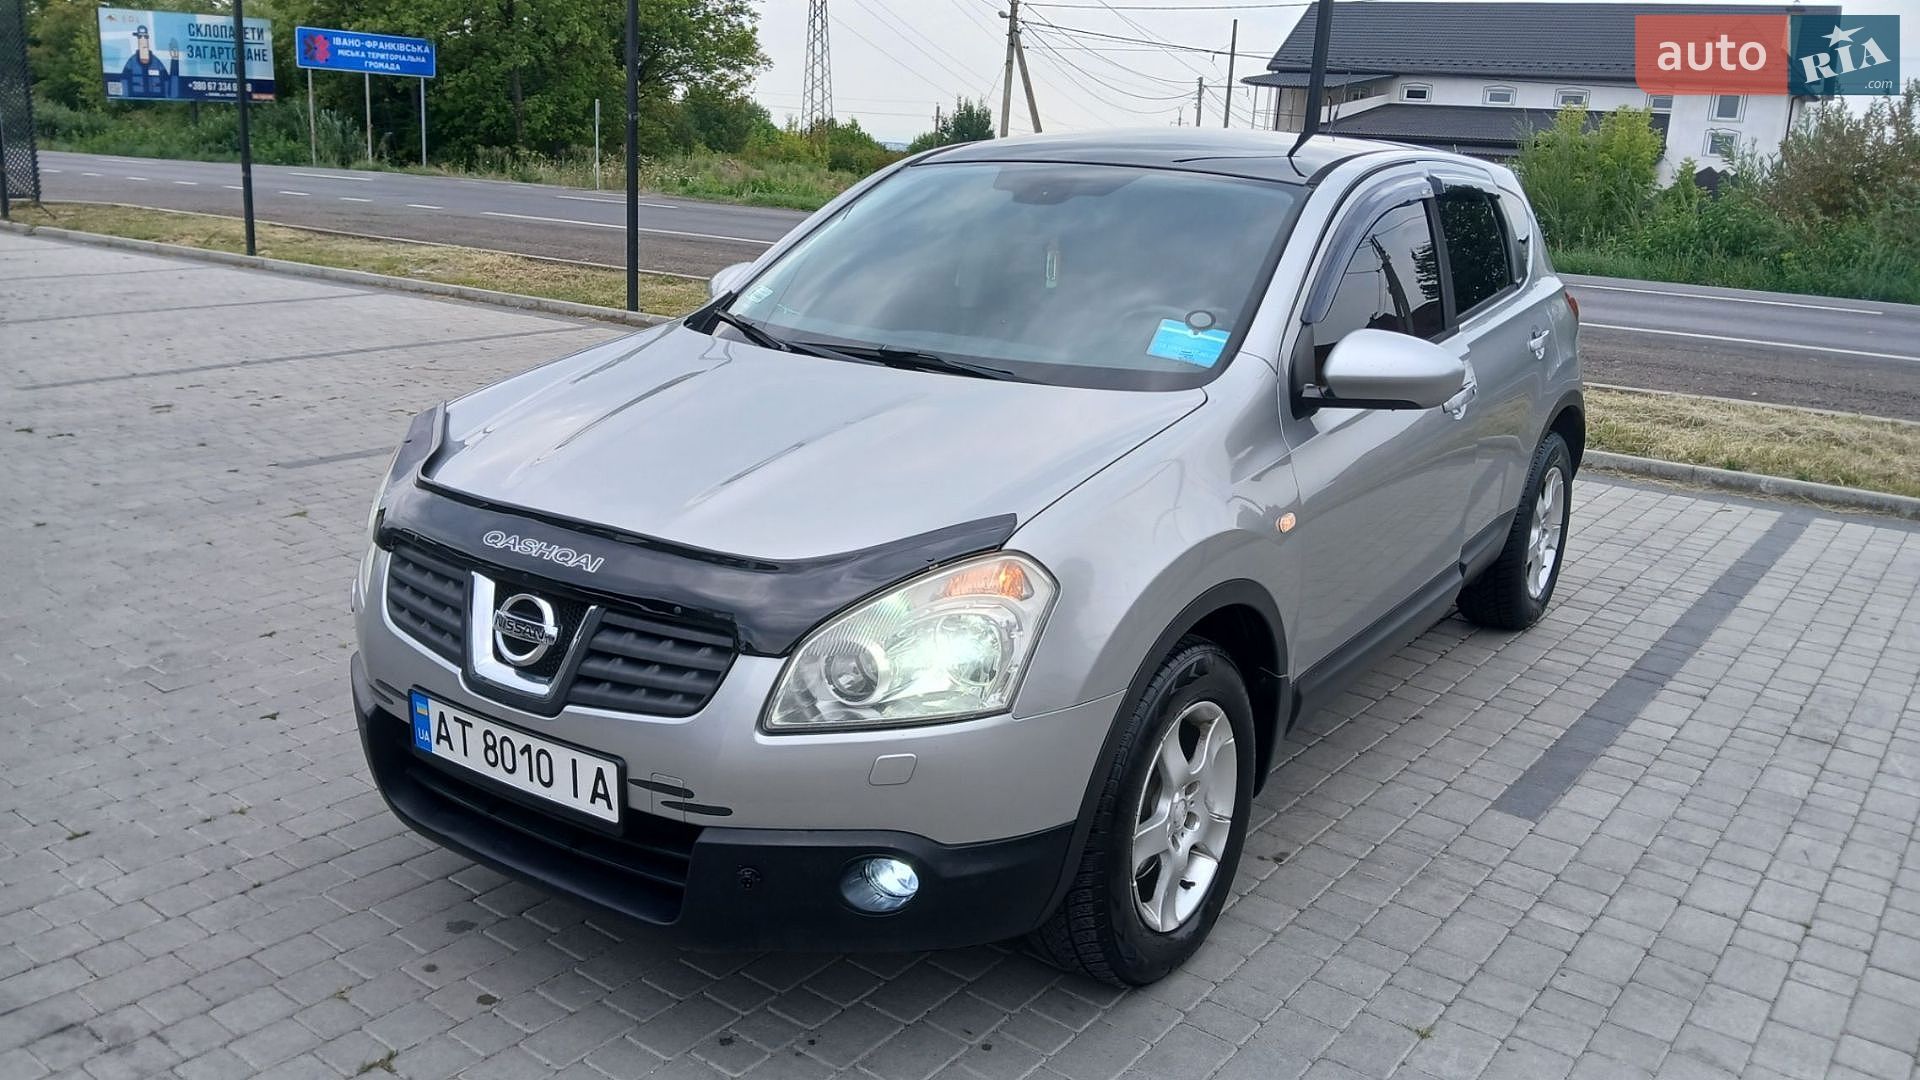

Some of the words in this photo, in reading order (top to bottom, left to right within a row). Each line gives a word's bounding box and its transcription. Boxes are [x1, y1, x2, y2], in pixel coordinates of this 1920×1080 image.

[188, 23, 264, 40] СКЛОПАЕТИ
[187, 44, 268, 62] ЗАГАРТОАНЕ
[332, 36, 430, 54] ІВАНО-ФРАНКІВСЬКА
[337, 49, 366, 59] МІСЬКА
[367, 51, 427, 64] ТЕРИТОРІАЛЬНА
[214, 61, 238, 75] СКЛ
[364, 60, 401, 71] ГРОМАДА
[483, 530, 605, 573] QASHQAI
[495, 611, 547, 642] NISSAN
[417, 727, 430, 743] UA
[436, 711, 473, 757] AT
[483, 729, 554, 788] 8010
[571, 758, 614, 811] IA
